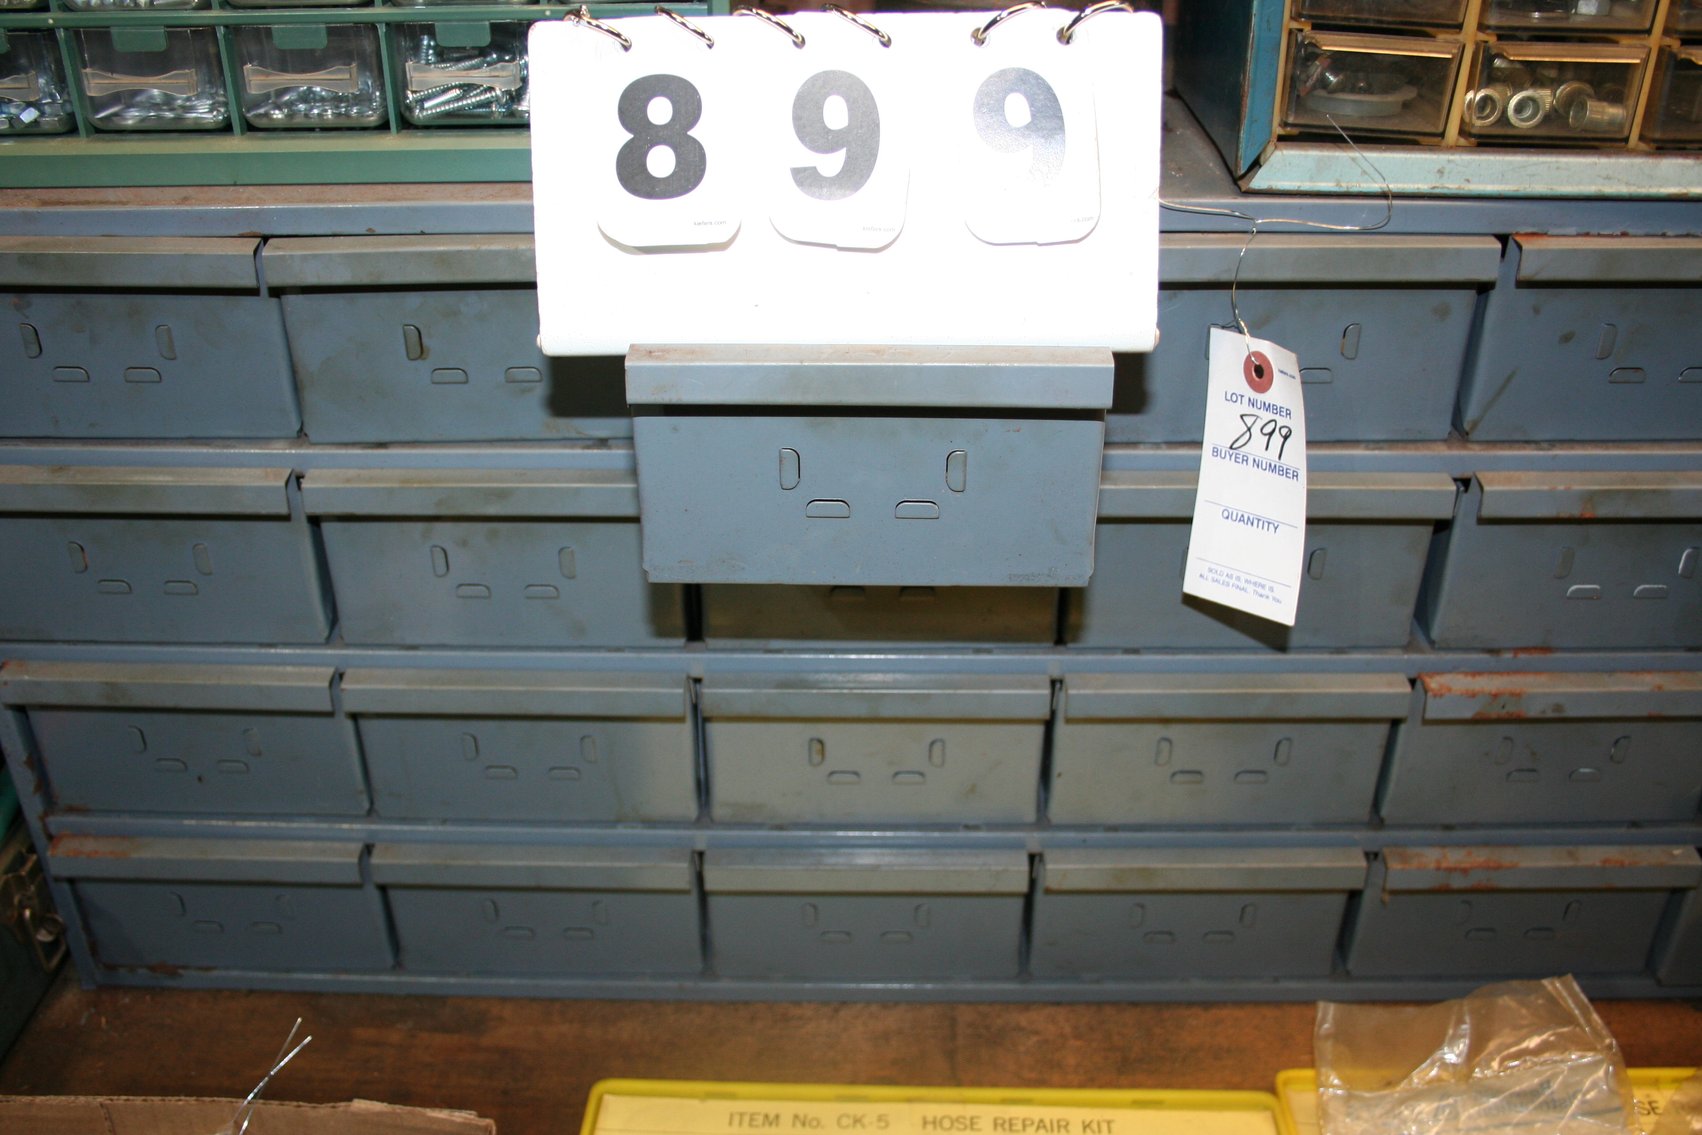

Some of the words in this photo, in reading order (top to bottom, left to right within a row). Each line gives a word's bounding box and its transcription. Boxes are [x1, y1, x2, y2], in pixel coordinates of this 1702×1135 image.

[616, 74, 708, 200] 8
[789, 69, 881, 201] 9
[972, 67, 1067, 188] 9
[1224, 391, 1245, 405] LOT
[1247, 396, 1292, 420] NUMBER
[1229, 413, 1292, 461] 899
[1211, 446, 1249, 466] BUYER
[1252, 457, 1299, 482] NUMBER
[1221, 508, 1280, 534] QUANTITY
[1199, 573, 1209, 581] ALL
[1212, 577, 1230, 587] SALES
[1253, 590, 1269, 599] Thank
[1208, 567, 1224, 577] SOLD
[1226, 572, 1234, 580] AS
[1244, 579, 1266, 590] WHERE
[728, 1111, 781, 1129] ITEM
[791, 1112, 825, 1130] No.
[921, 1114, 983, 1132] HOSE
[993, 1115, 1071, 1134] REPAIR
[1081, 1118, 1117, 1135] KIT
